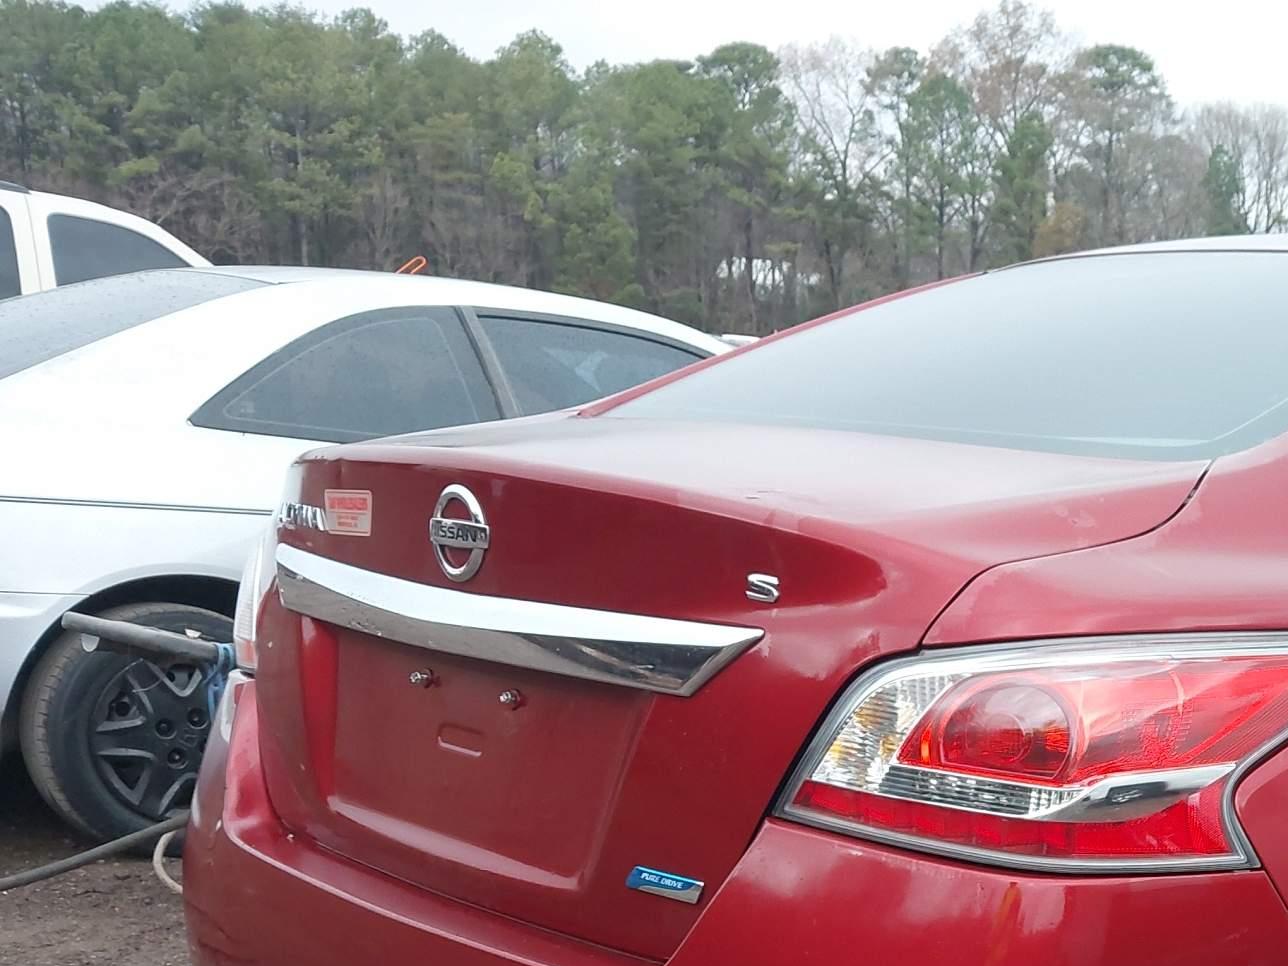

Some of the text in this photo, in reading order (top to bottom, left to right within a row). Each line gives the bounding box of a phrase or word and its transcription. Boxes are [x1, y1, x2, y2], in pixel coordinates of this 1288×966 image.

[745, 573, 780, 603] S
[640, 872, 684, 889] PURE DRIVE
